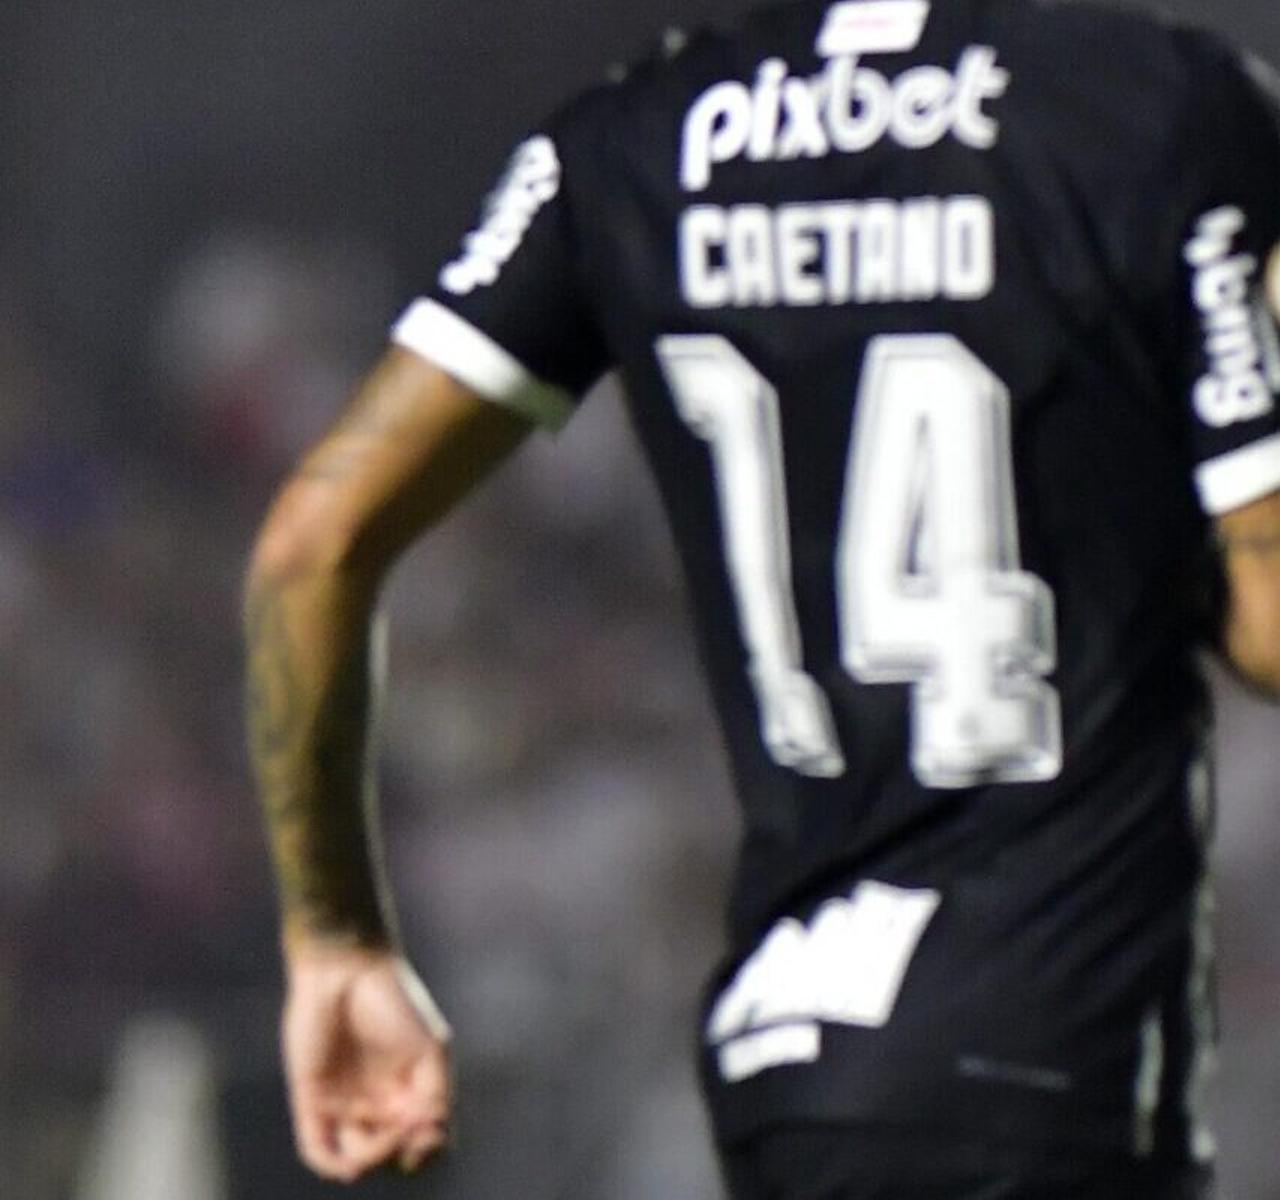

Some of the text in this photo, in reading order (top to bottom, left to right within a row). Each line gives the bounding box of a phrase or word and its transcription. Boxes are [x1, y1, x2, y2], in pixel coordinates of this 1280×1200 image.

[680, 43, 1011, 193] pixbet
[678, 194, 995, 310] CAETANO
[653, 332, 1064, 789] 14
